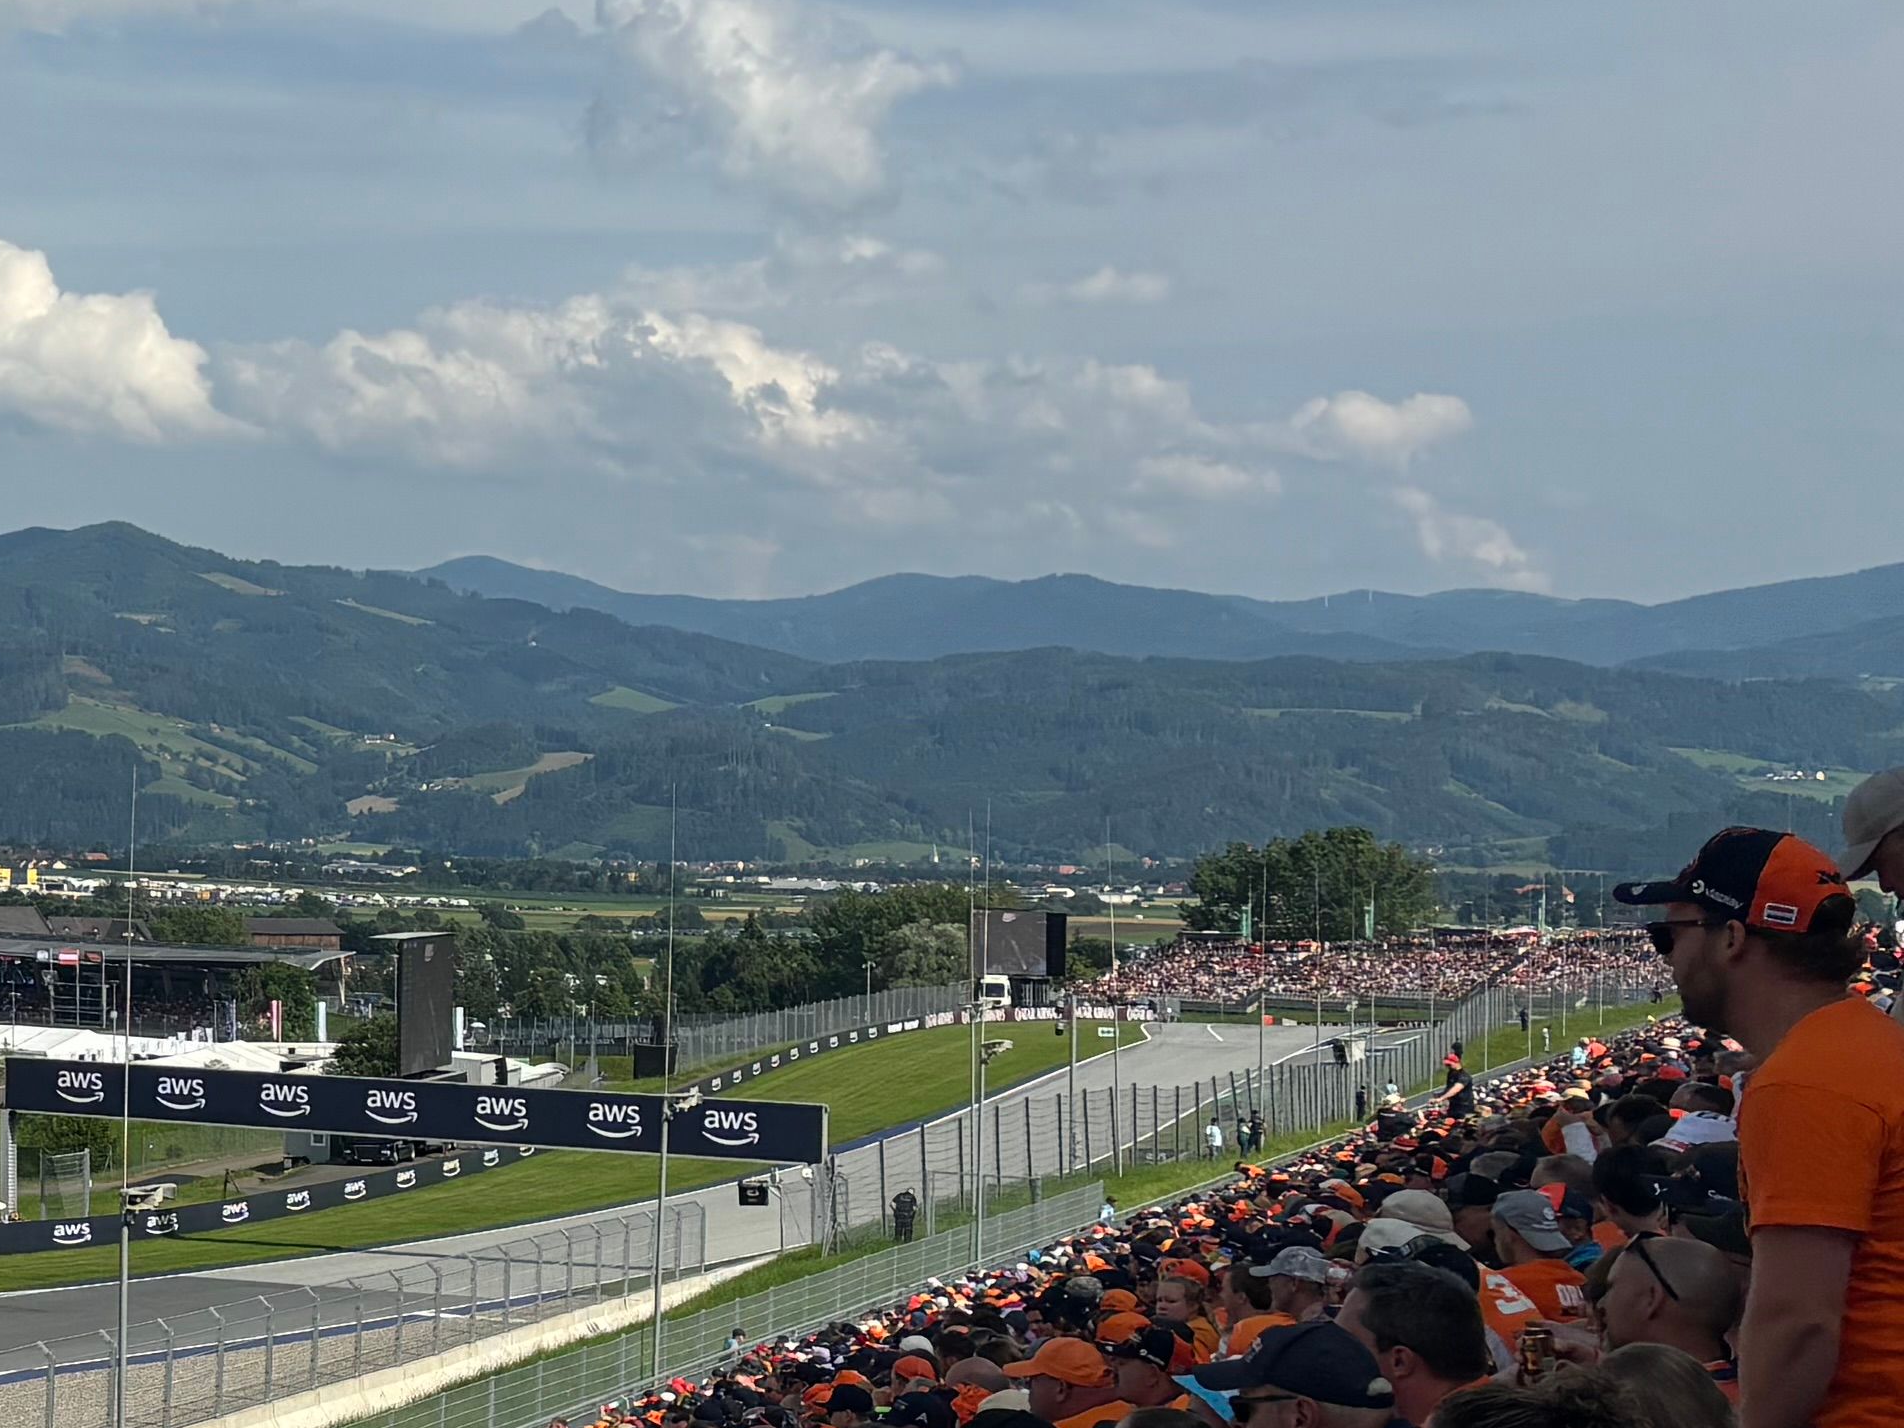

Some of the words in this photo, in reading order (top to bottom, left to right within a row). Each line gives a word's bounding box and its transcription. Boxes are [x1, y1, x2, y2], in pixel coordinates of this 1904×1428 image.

[57, 1070, 102, 1091] aws
[157, 1076, 204, 1097] aws
[261, 1081, 309, 1103] aws
[366, 1088, 416, 1111] aws
[476, 1095, 527, 1117] aws
[588, 1102, 640, 1124] aws
[703, 1109, 758, 1131] aws
[53, 1222, 91, 1238] aws
[147, 1213, 178, 1227] aws
[222, 1201, 248, 1215] aws
